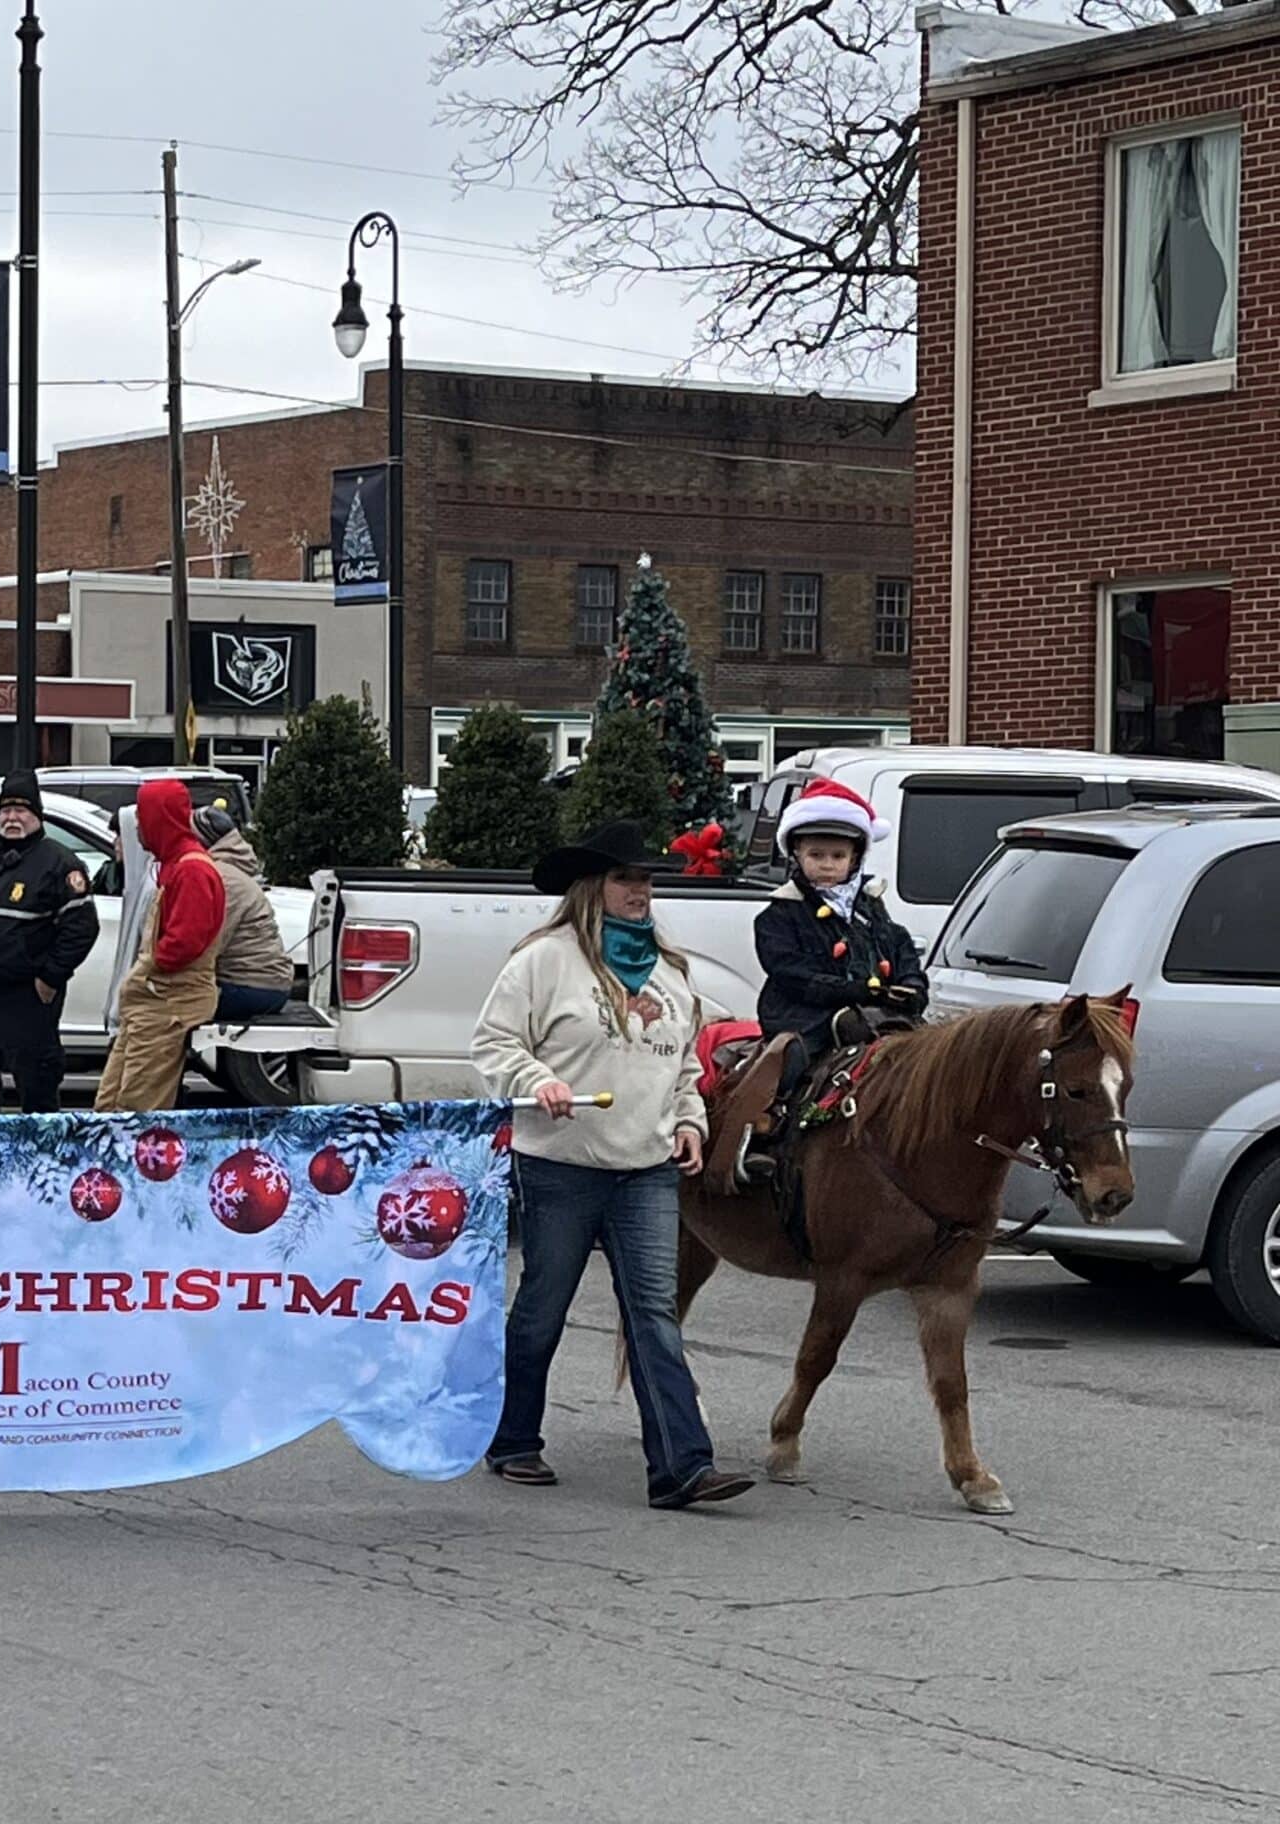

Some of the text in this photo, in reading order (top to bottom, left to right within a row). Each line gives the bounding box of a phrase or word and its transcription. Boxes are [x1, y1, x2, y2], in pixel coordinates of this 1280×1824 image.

[87, 1371, 172, 1394] County
[25, 1399, 52, 1418] of
[56, 1397, 183, 1418] Commerce
[26, 1431, 103, 1446] COMMUNITY
[104, 1425, 183, 1441] CONNECTION
